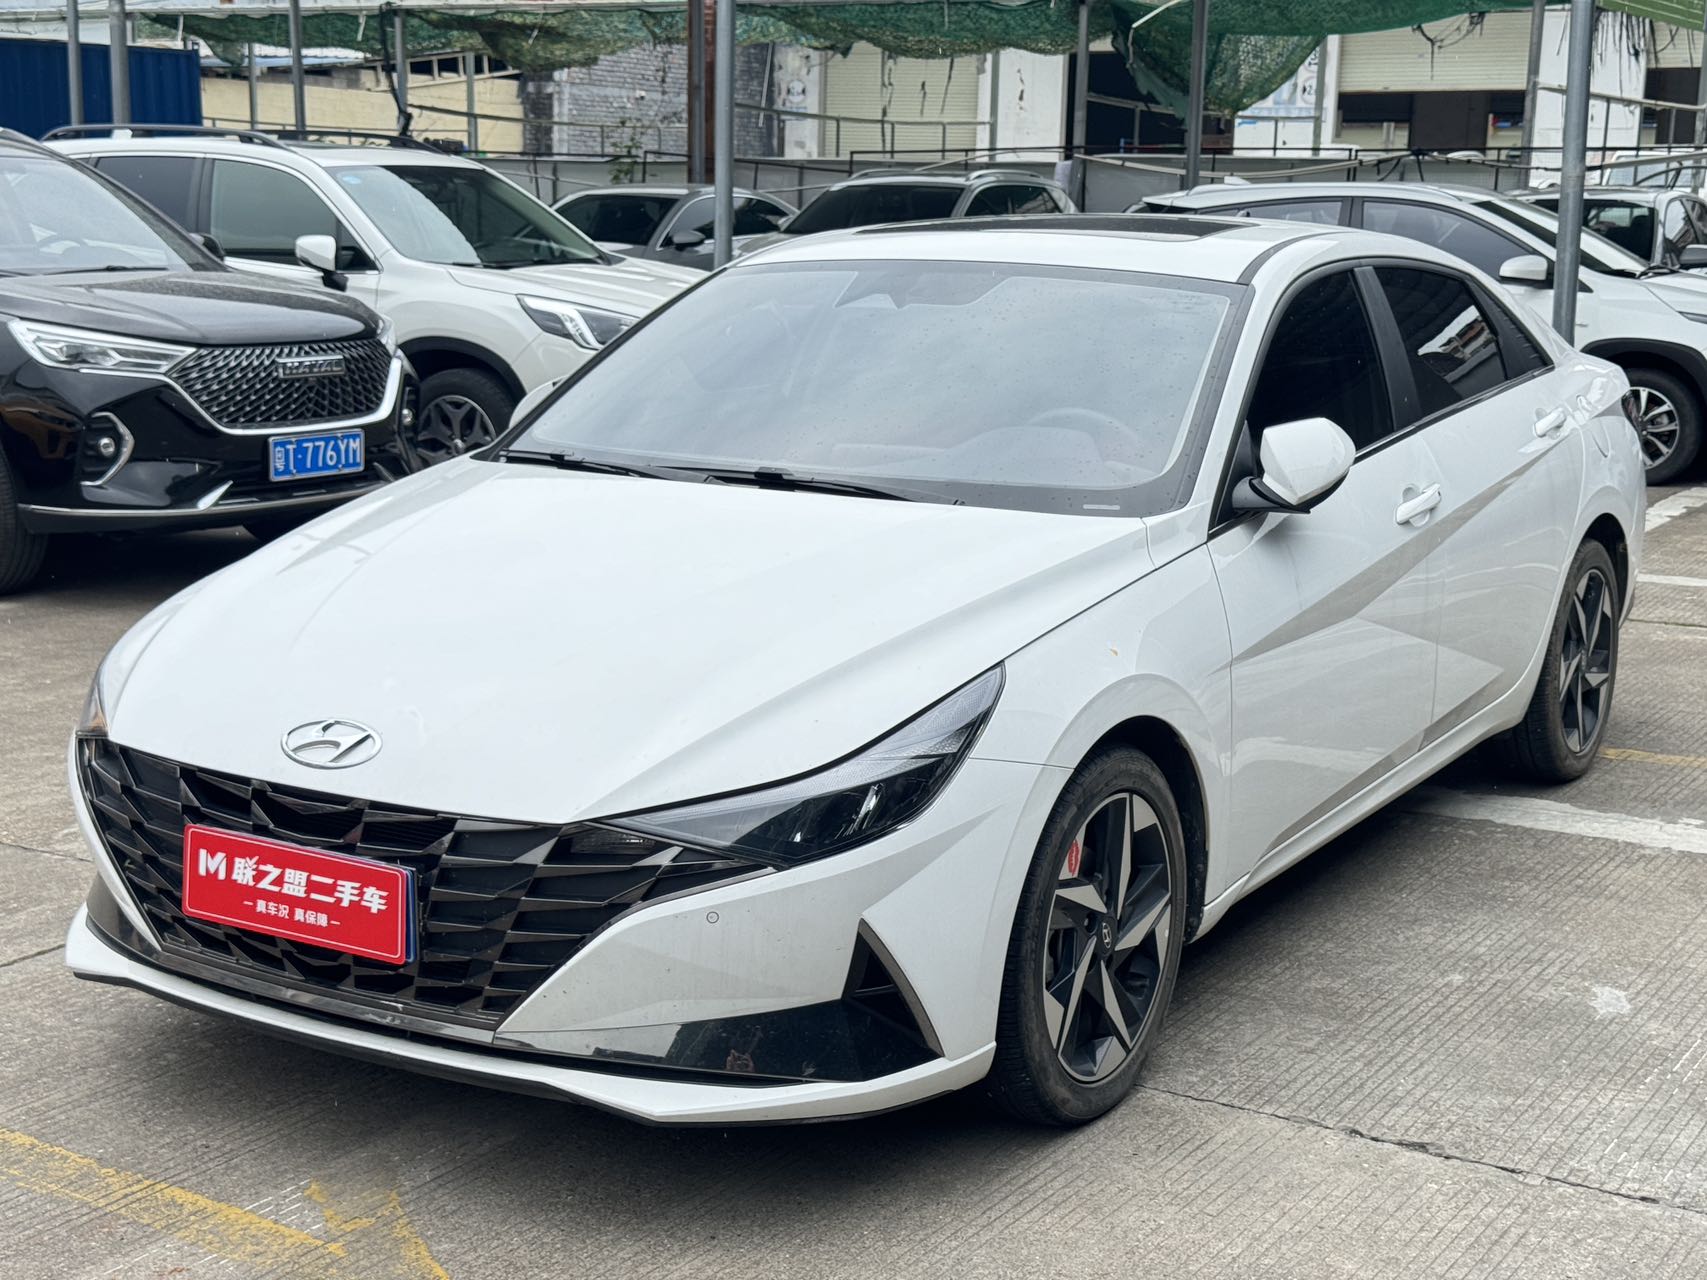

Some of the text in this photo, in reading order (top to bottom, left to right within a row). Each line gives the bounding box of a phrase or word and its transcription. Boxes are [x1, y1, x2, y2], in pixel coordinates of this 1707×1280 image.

[231, 855, 390, 914] 联之盟二手车
[255, 899, 329, 928] 真车况 真保障
